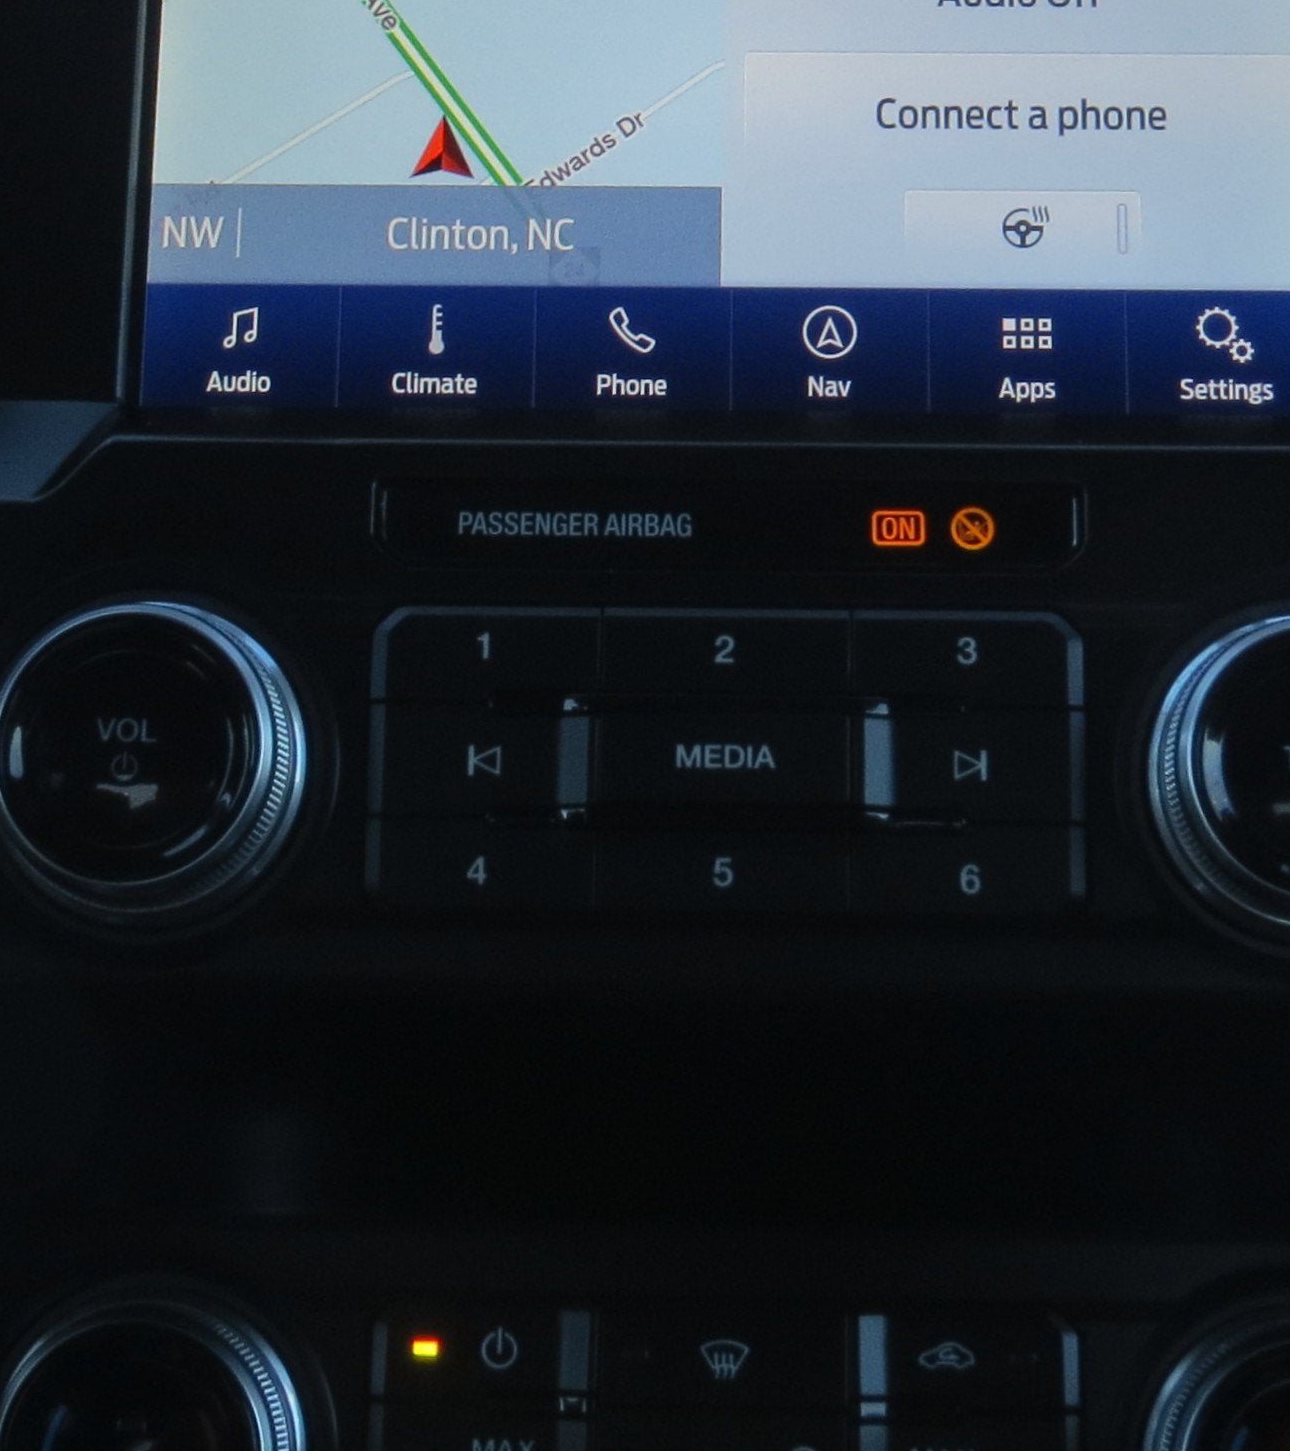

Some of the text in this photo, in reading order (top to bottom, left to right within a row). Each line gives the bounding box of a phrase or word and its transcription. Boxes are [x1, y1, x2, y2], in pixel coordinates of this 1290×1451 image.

[616, 112, 644, 138] Dr
[875, 97, 1168, 136] Connect a phone
[162, 215, 225, 249] NW
[386, 216, 575, 256] Clinton, NC
[206, 371, 272, 395] Audio
[391, 372, 478, 396] Climate
[596, 374, 668, 397] Phone
[807, 376, 851, 398] Nav
[998, 378, 1056, 405] Apps
[1180, 378, 1274, 407] Settings
[457, 511, 693, 539] PASSENGER AIRBAG
[880, 515, 916, 541] ON
[476, 632, 491, 661] 1
[713, 635, 735, 664] 2
[956, 636, 978, 665] 3
[96, 717, 157, 743] VOL
[675, 744, 776, 770] MEDIA
[466, 857, 488, 885] 4
[713, 857, 734, 887] 5
[960, 864, 981, 894] 6
